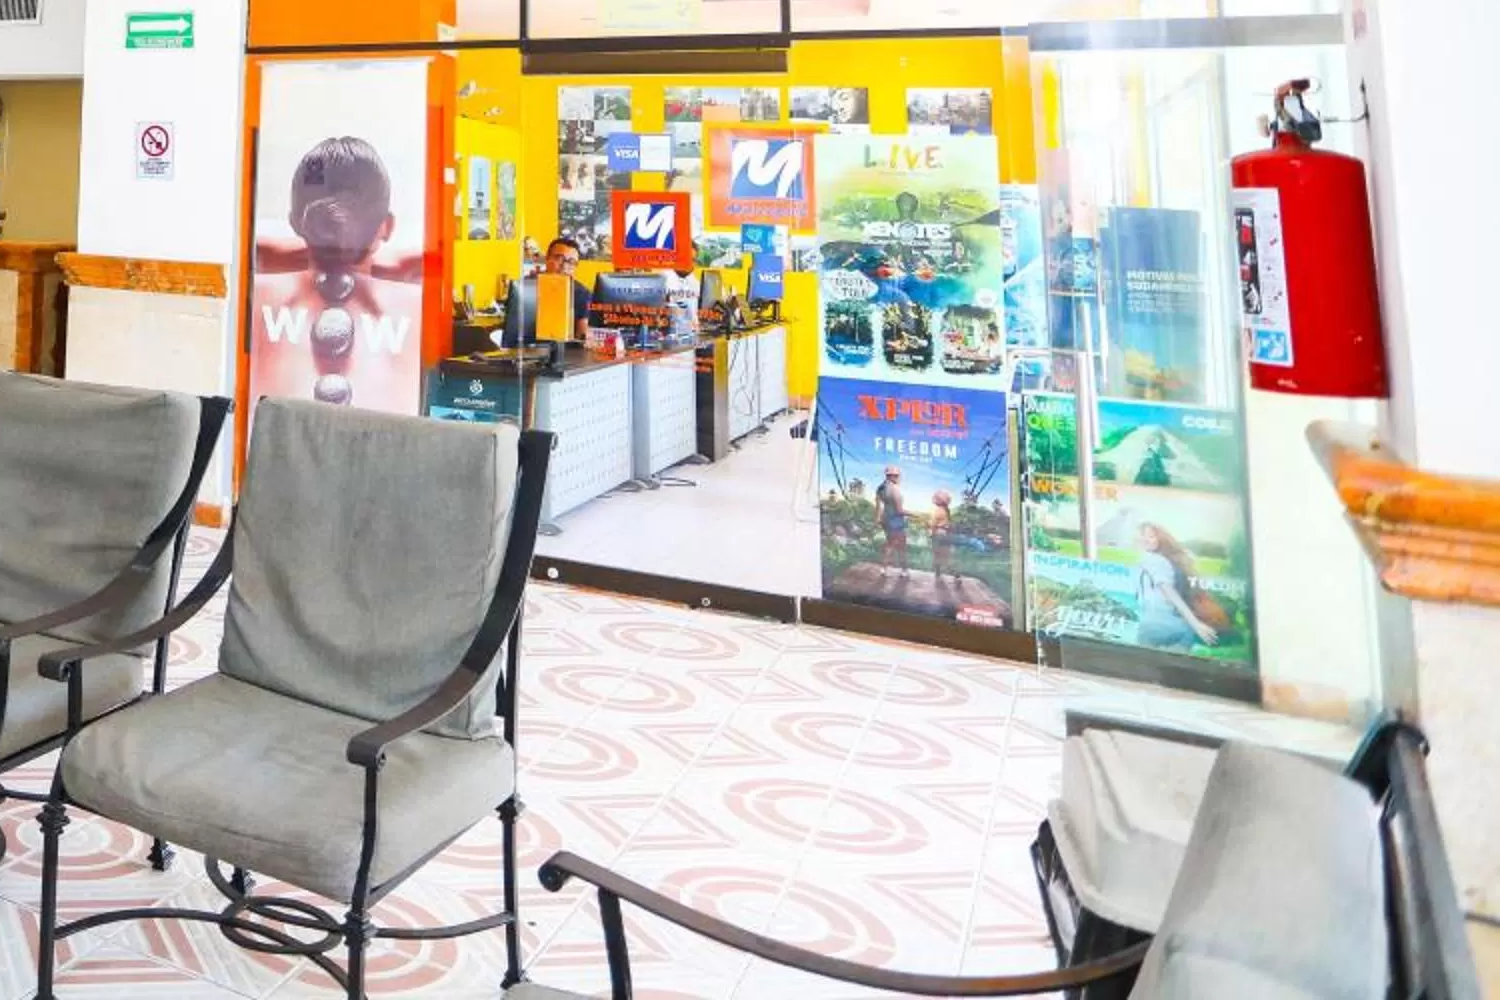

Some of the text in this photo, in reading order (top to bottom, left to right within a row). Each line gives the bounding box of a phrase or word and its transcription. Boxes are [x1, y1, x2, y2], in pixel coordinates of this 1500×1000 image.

[614, 149, 639, 160] VISA
[758, 272, 781, 284] VISA
[873, 436, 958, 460] FREEDOM
[1033, 554, 1131, 577] INSPIRATION
